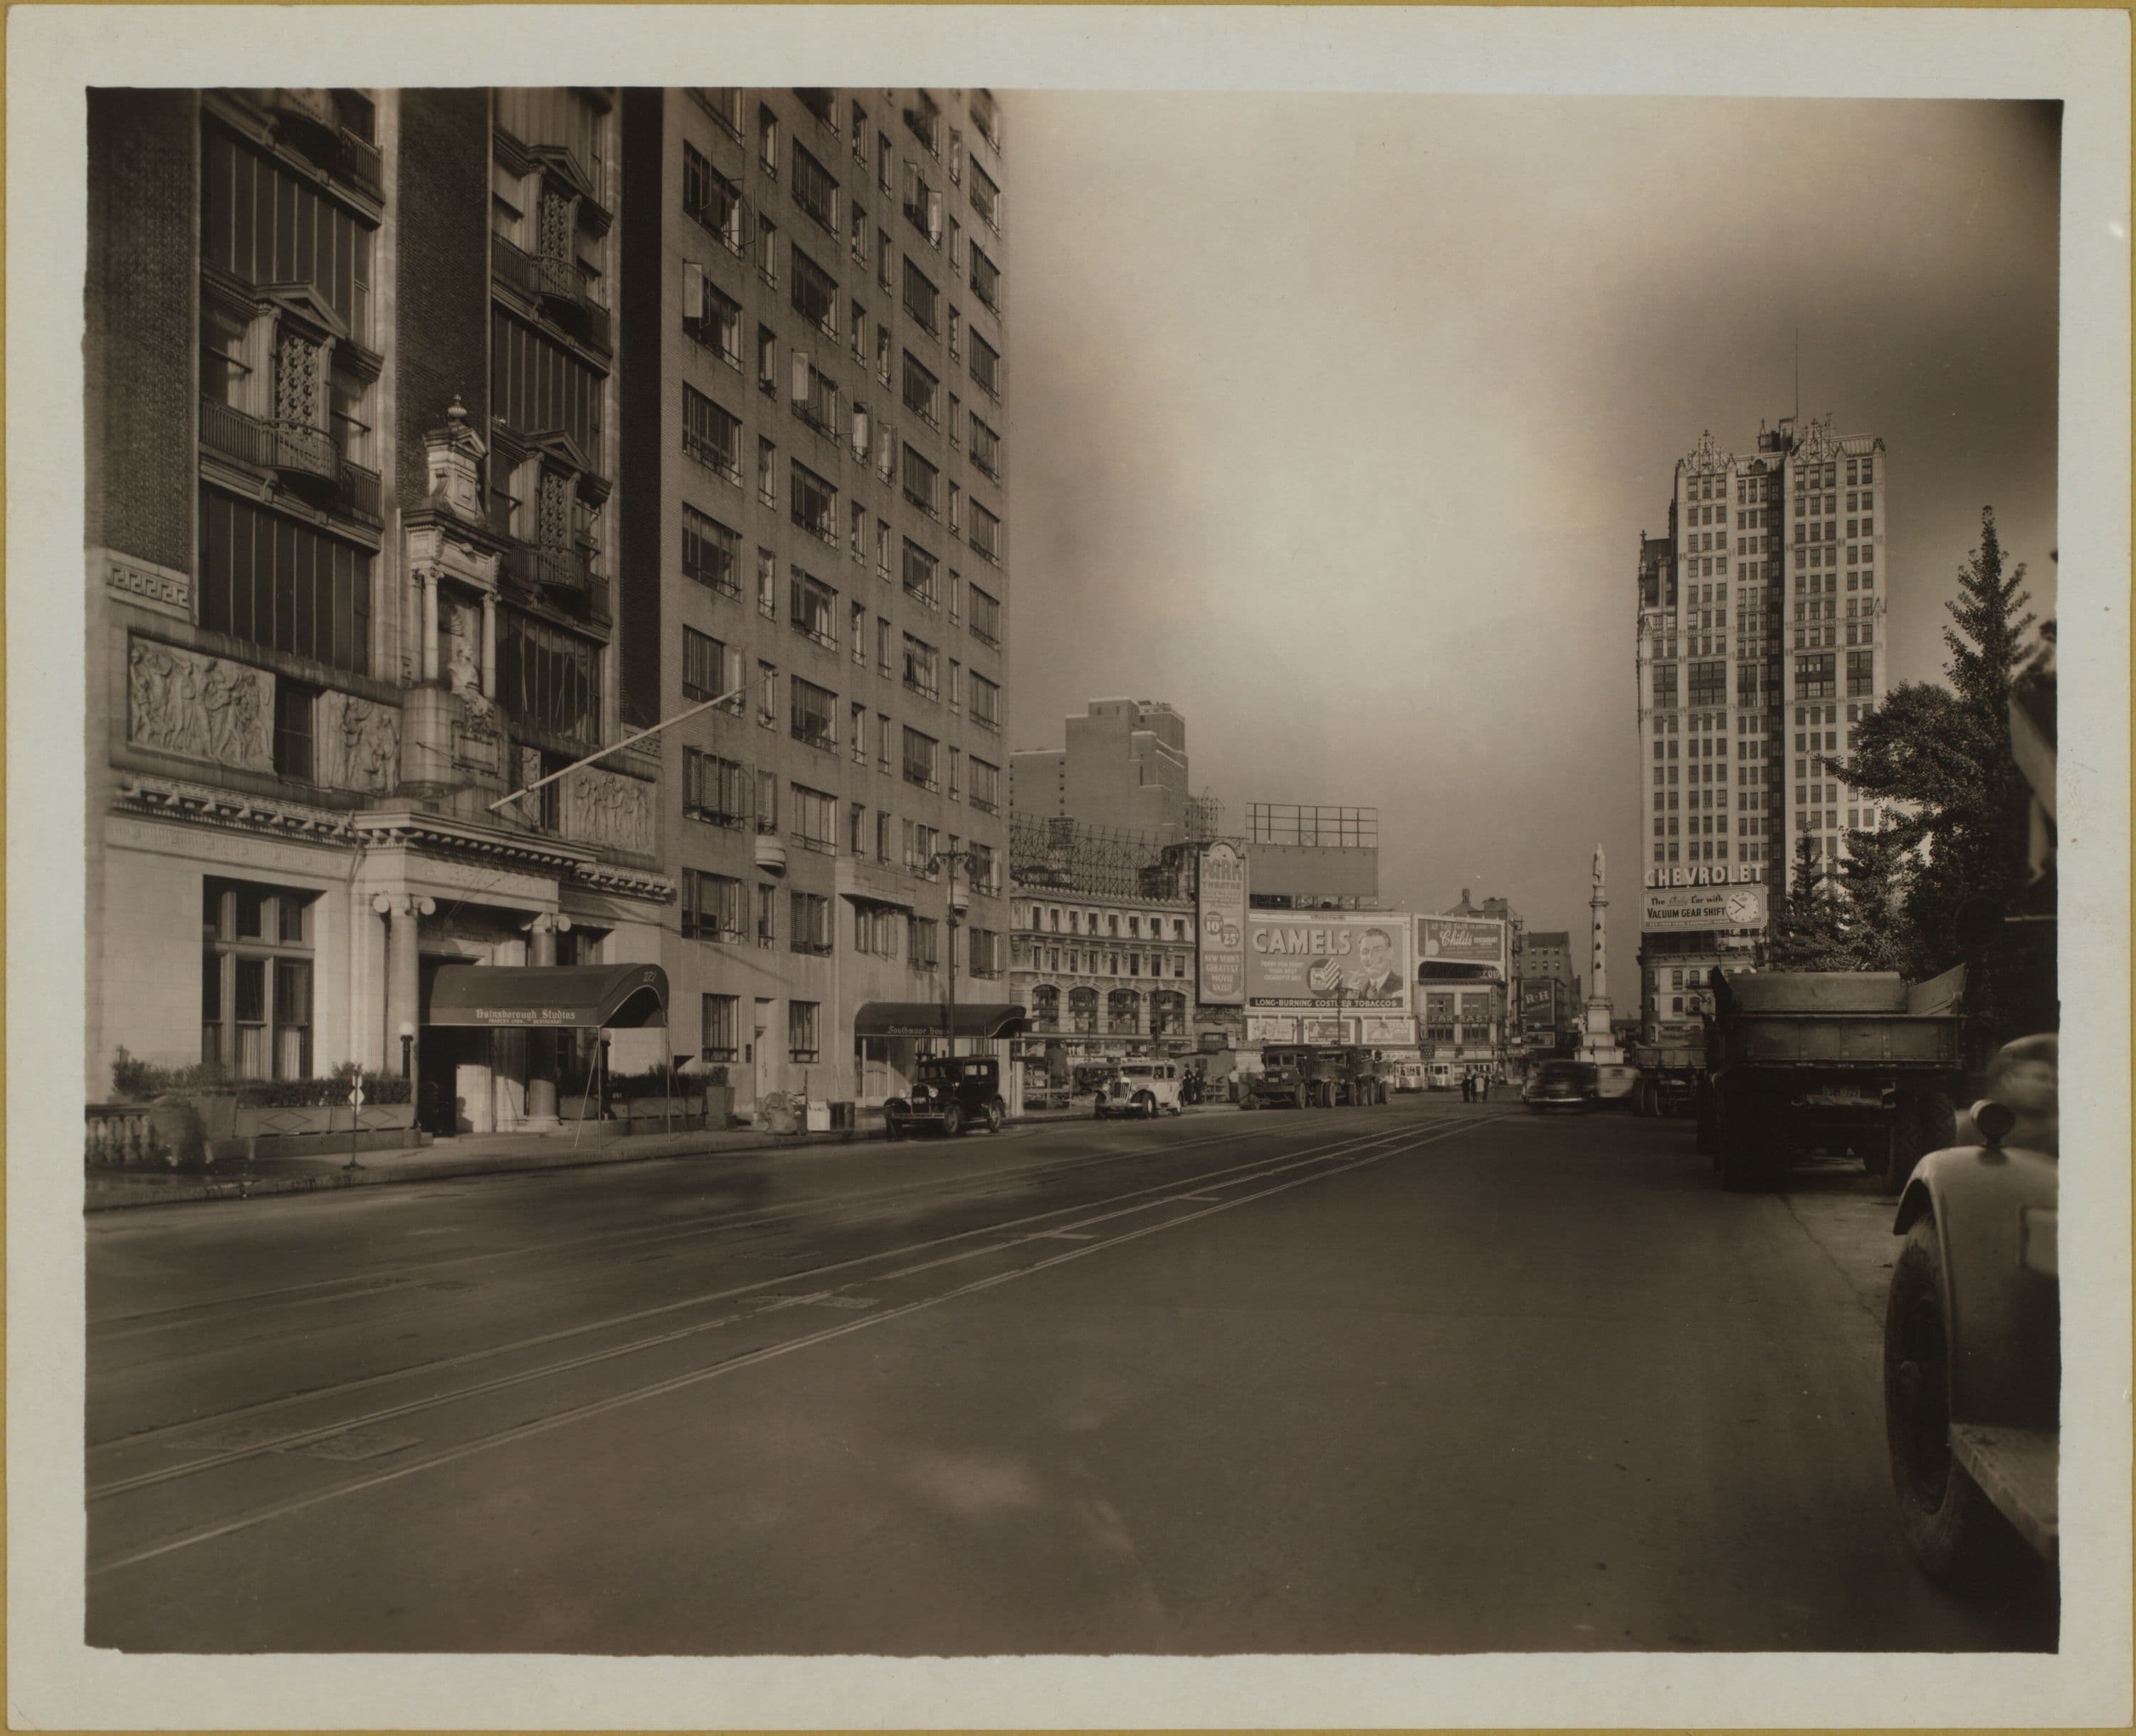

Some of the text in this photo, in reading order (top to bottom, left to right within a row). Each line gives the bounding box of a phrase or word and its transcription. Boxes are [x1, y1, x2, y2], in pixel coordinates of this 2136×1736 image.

[1201, 858, 1242, 880] PARK
[1645, 863, 1764, 887] CHEVROLET
[1706, 893, 1723, 903] with
[1647, 907, 1726, 919] VACUUM GEAR SHIFT
[1253, 927, 1352, 956] CAMELS
[1439, 930, 1473, 947] Childs
[1204, 954, 1218, 963] NEW
[1206, 964, 1238, 974] GREATEST
[1211, 974, 1233, 983] MOVIE
[1212, 983, 1232, 992] VALUE
[1255, 999, 1312, 1007] LONG-BURNING
[1315, 999, 1352, 1008] COSTLER
[476, 1008, 576, 1021] Gainsborough Studios
[1458, 1014, 1490, 1023] EAST
[888, 1025, 927, 1035] Southmoor
